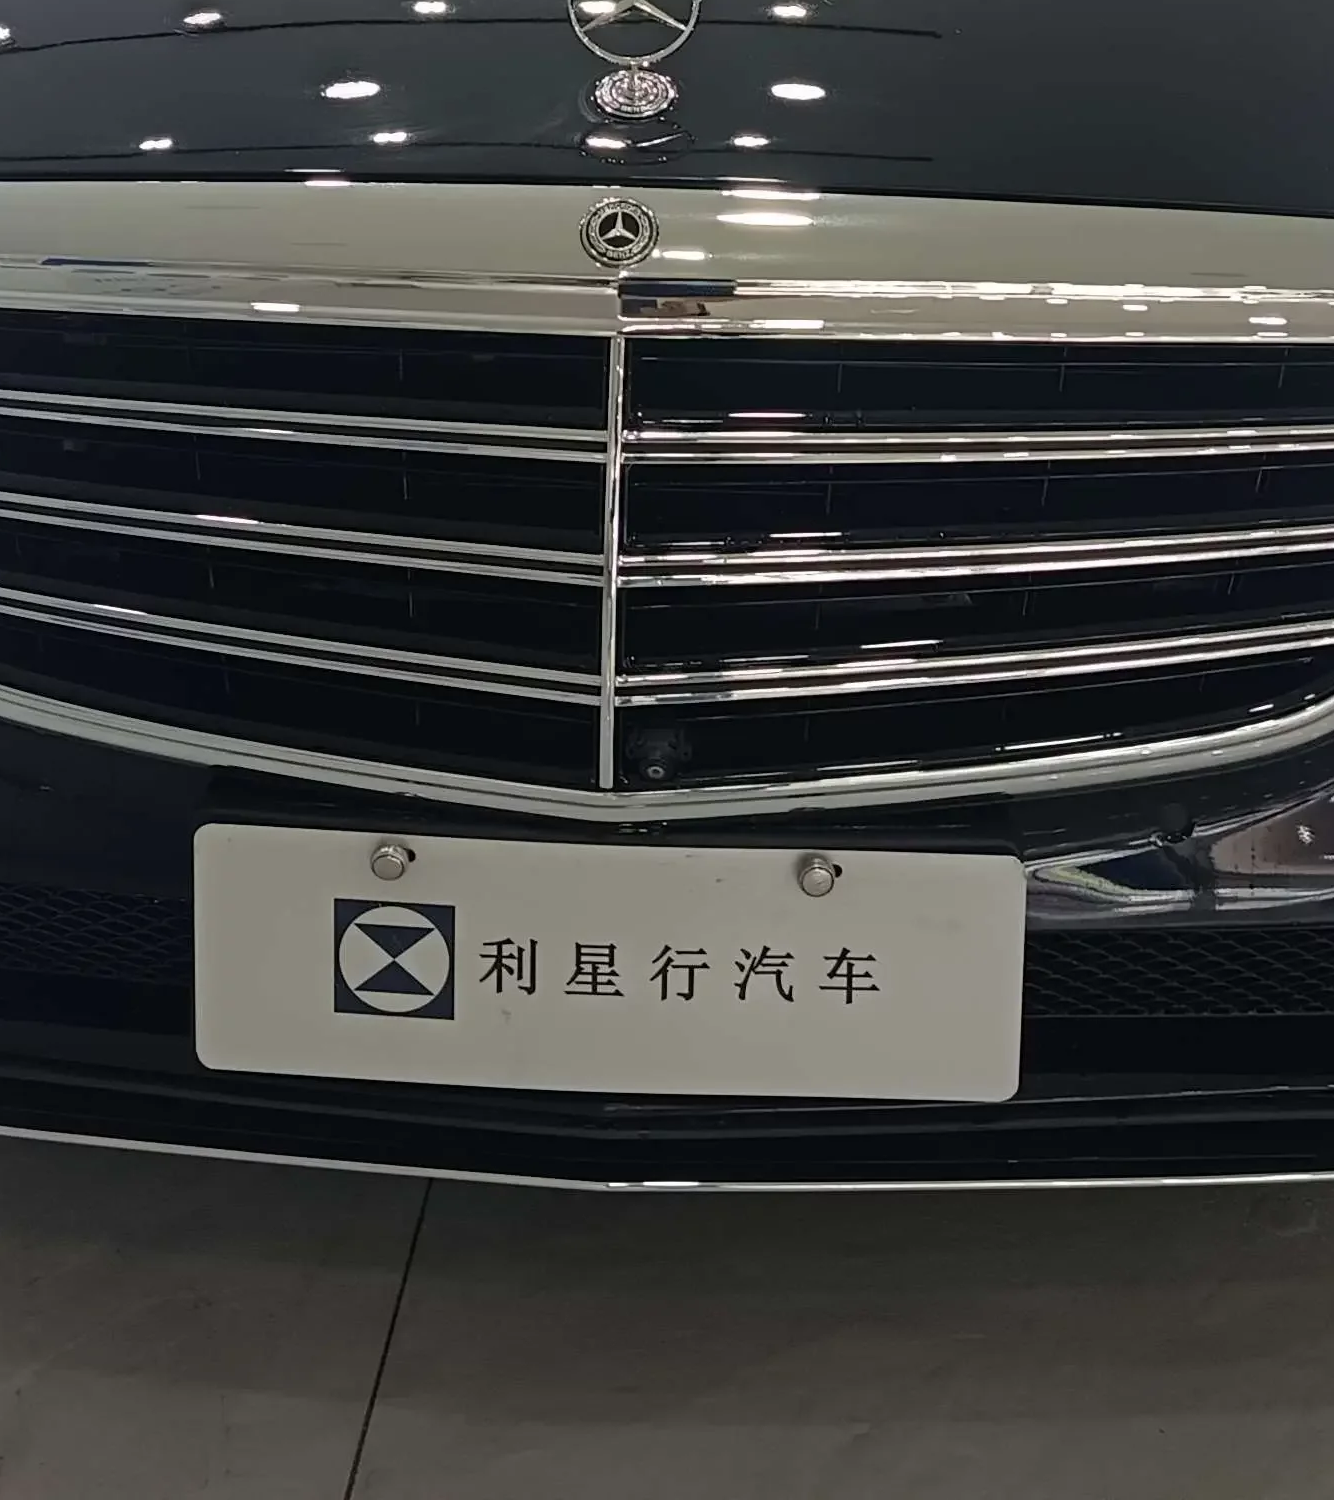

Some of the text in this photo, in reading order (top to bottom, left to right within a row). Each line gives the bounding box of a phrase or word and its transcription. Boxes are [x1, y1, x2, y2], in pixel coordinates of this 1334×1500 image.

[478, 936, 881, 1006] 利星行汽车
